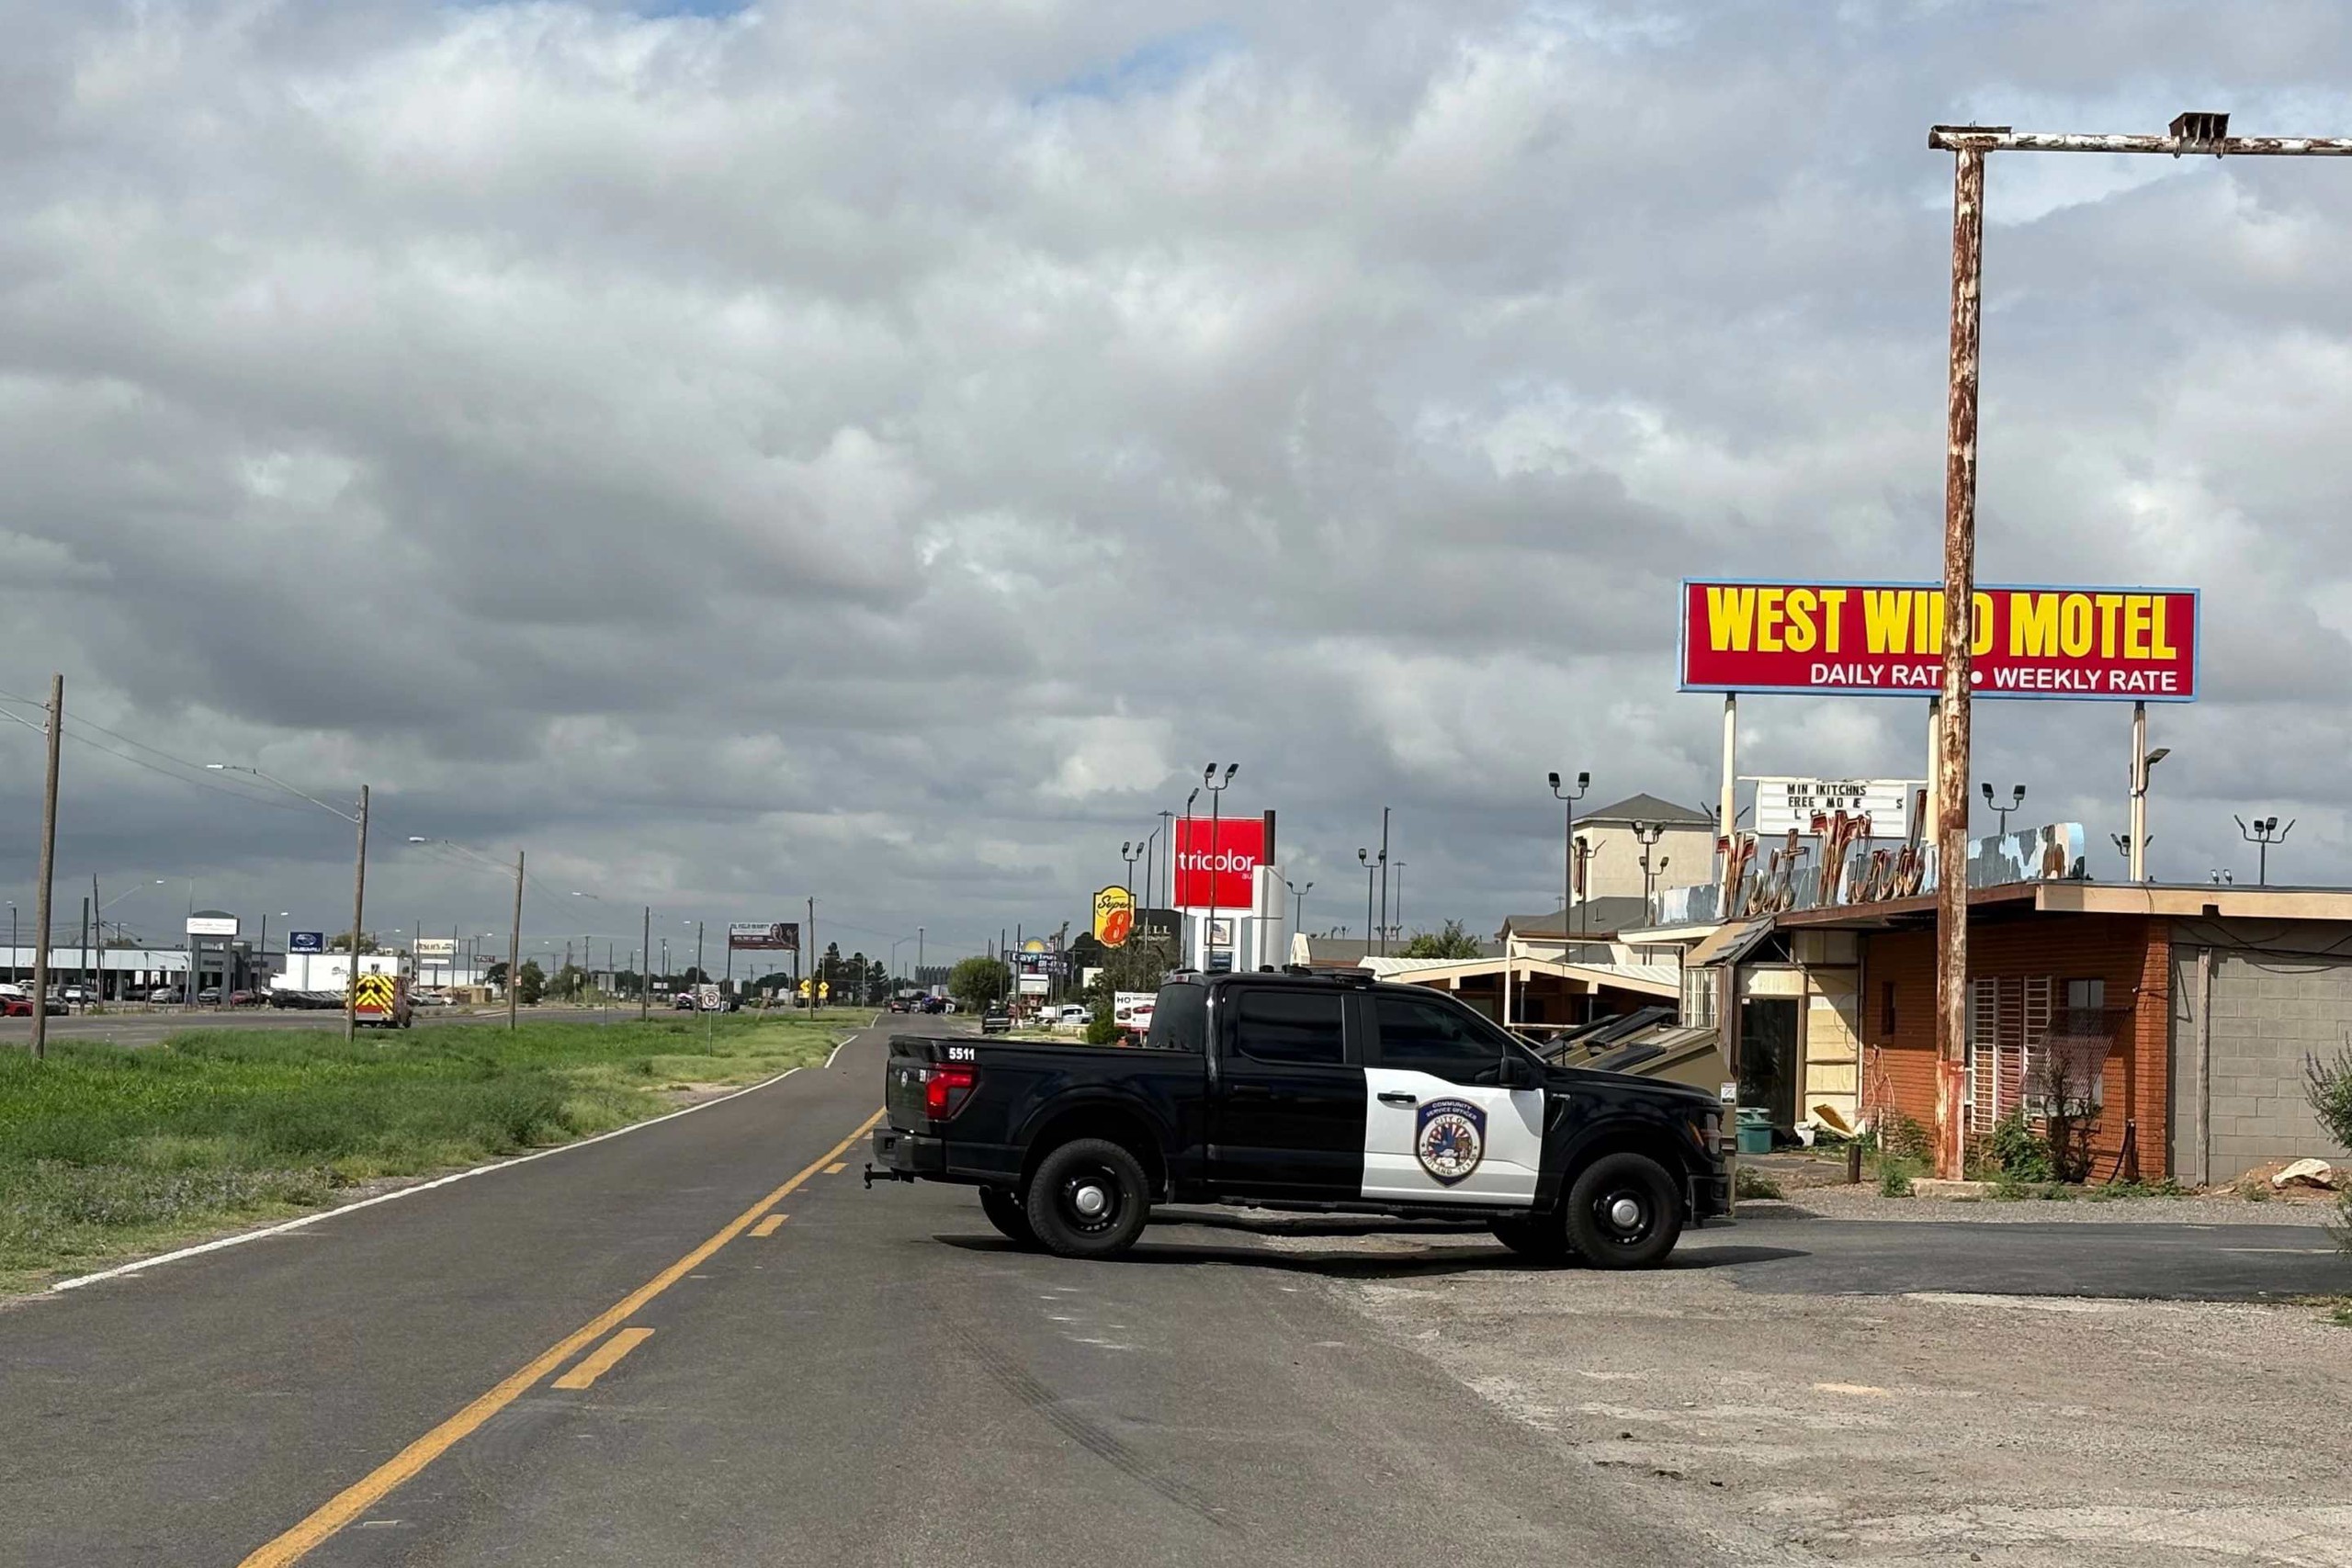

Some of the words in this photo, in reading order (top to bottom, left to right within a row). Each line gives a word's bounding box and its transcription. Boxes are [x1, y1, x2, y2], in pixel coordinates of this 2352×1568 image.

[1706, 587, 1847, 652] WEST
[2009, 592, 2177, 660] MOTEL
[1810, 663, 1884, 684] DAILY
[1892, 665, 1943, 685] RAT
[1993, 667, 2102, 689] WEEKLY
[2109, 670, 2177, 691] RATE
[1788, 796, 1815, 807] FREE
[1179, 848, 1255, 873] tricolor
[1101, 910, 1132, 944] 8
[949, 1047, 975, 1060] 5511
[1432, 1100, 1473, 1111] COMMUNITY
[1426, 1107, 1452, 1117] SERVICE
[1452, 1107, 1477, 1121] OFFICER
[1434, 1115, 1453, 1125] CITY
[1456, 1117, 1467, 1125] OF
